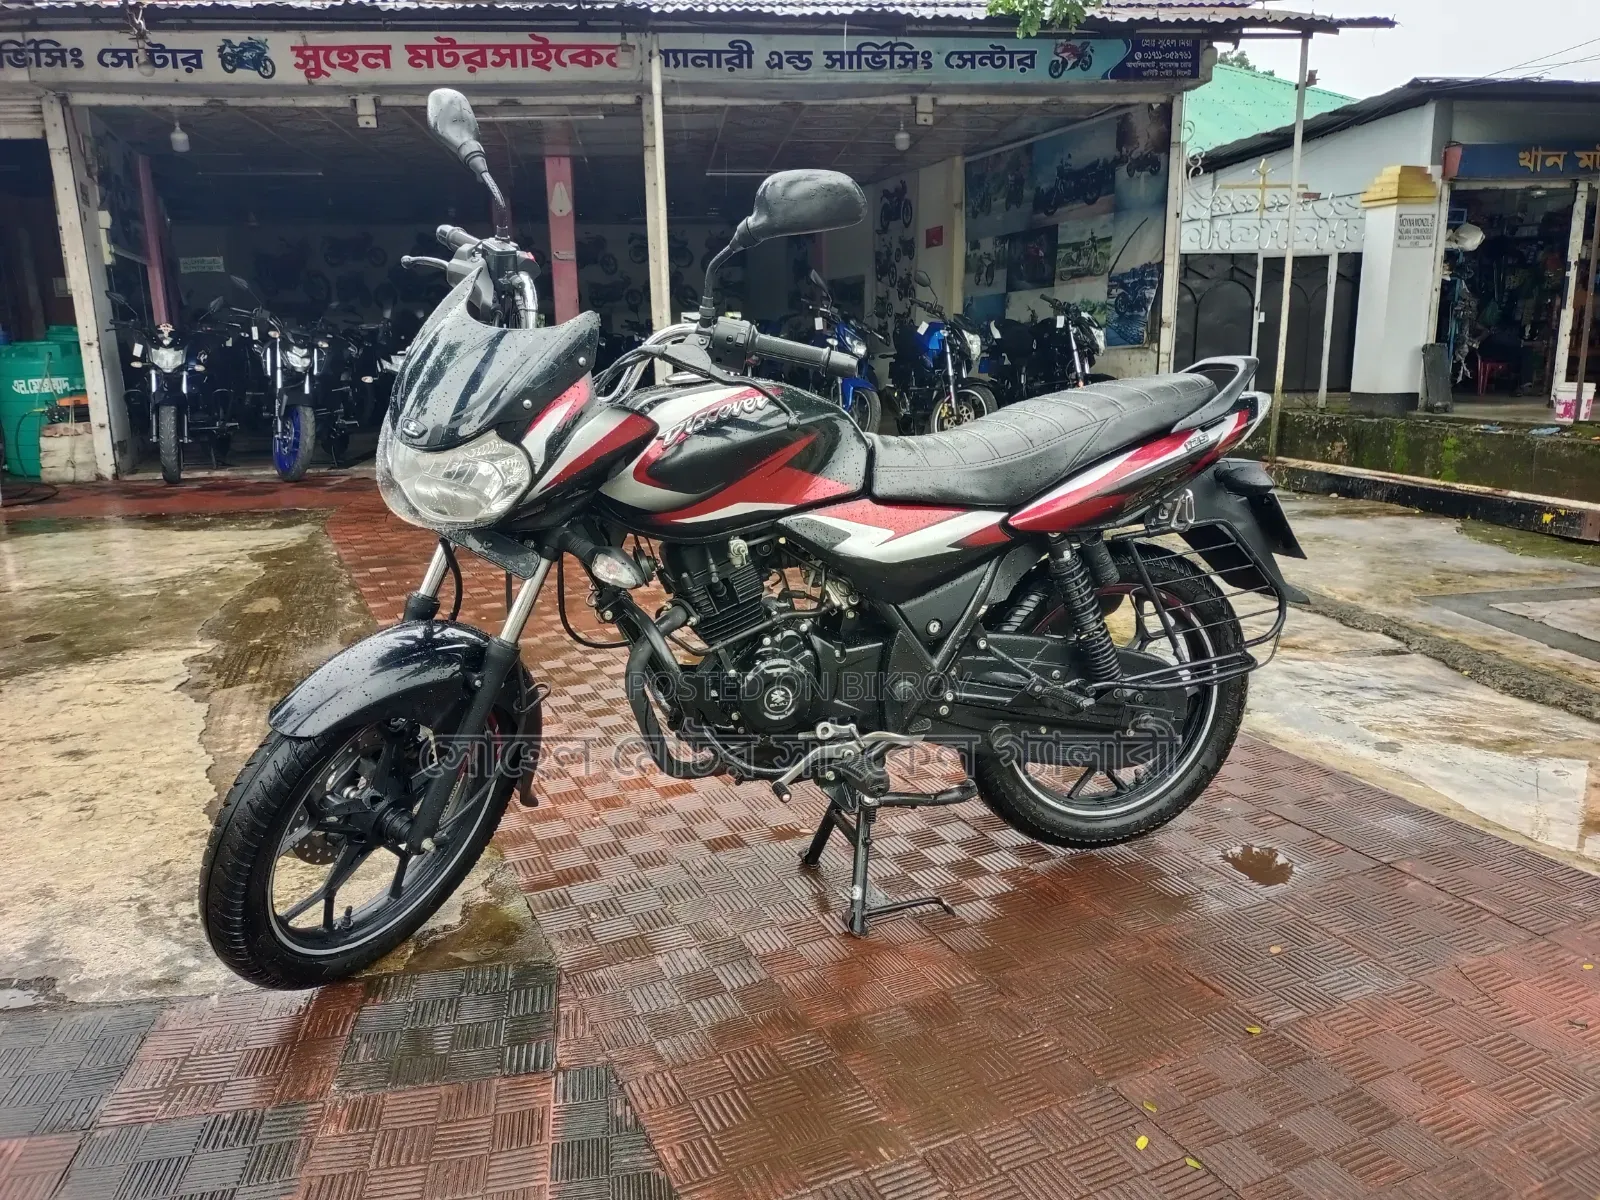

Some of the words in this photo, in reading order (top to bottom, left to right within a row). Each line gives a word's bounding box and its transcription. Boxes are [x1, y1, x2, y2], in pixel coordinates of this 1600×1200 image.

[290, 44, 392, 80] সুহেল
[764, 49, 814, 72] এন্ড
[822, 40, 933, 71] সার্ভিসিং
[944, 43, 1038, 74] সেন্টার
[1518, 145, 1568, 173] খান
[1573, 142, 1600, 172] ম
